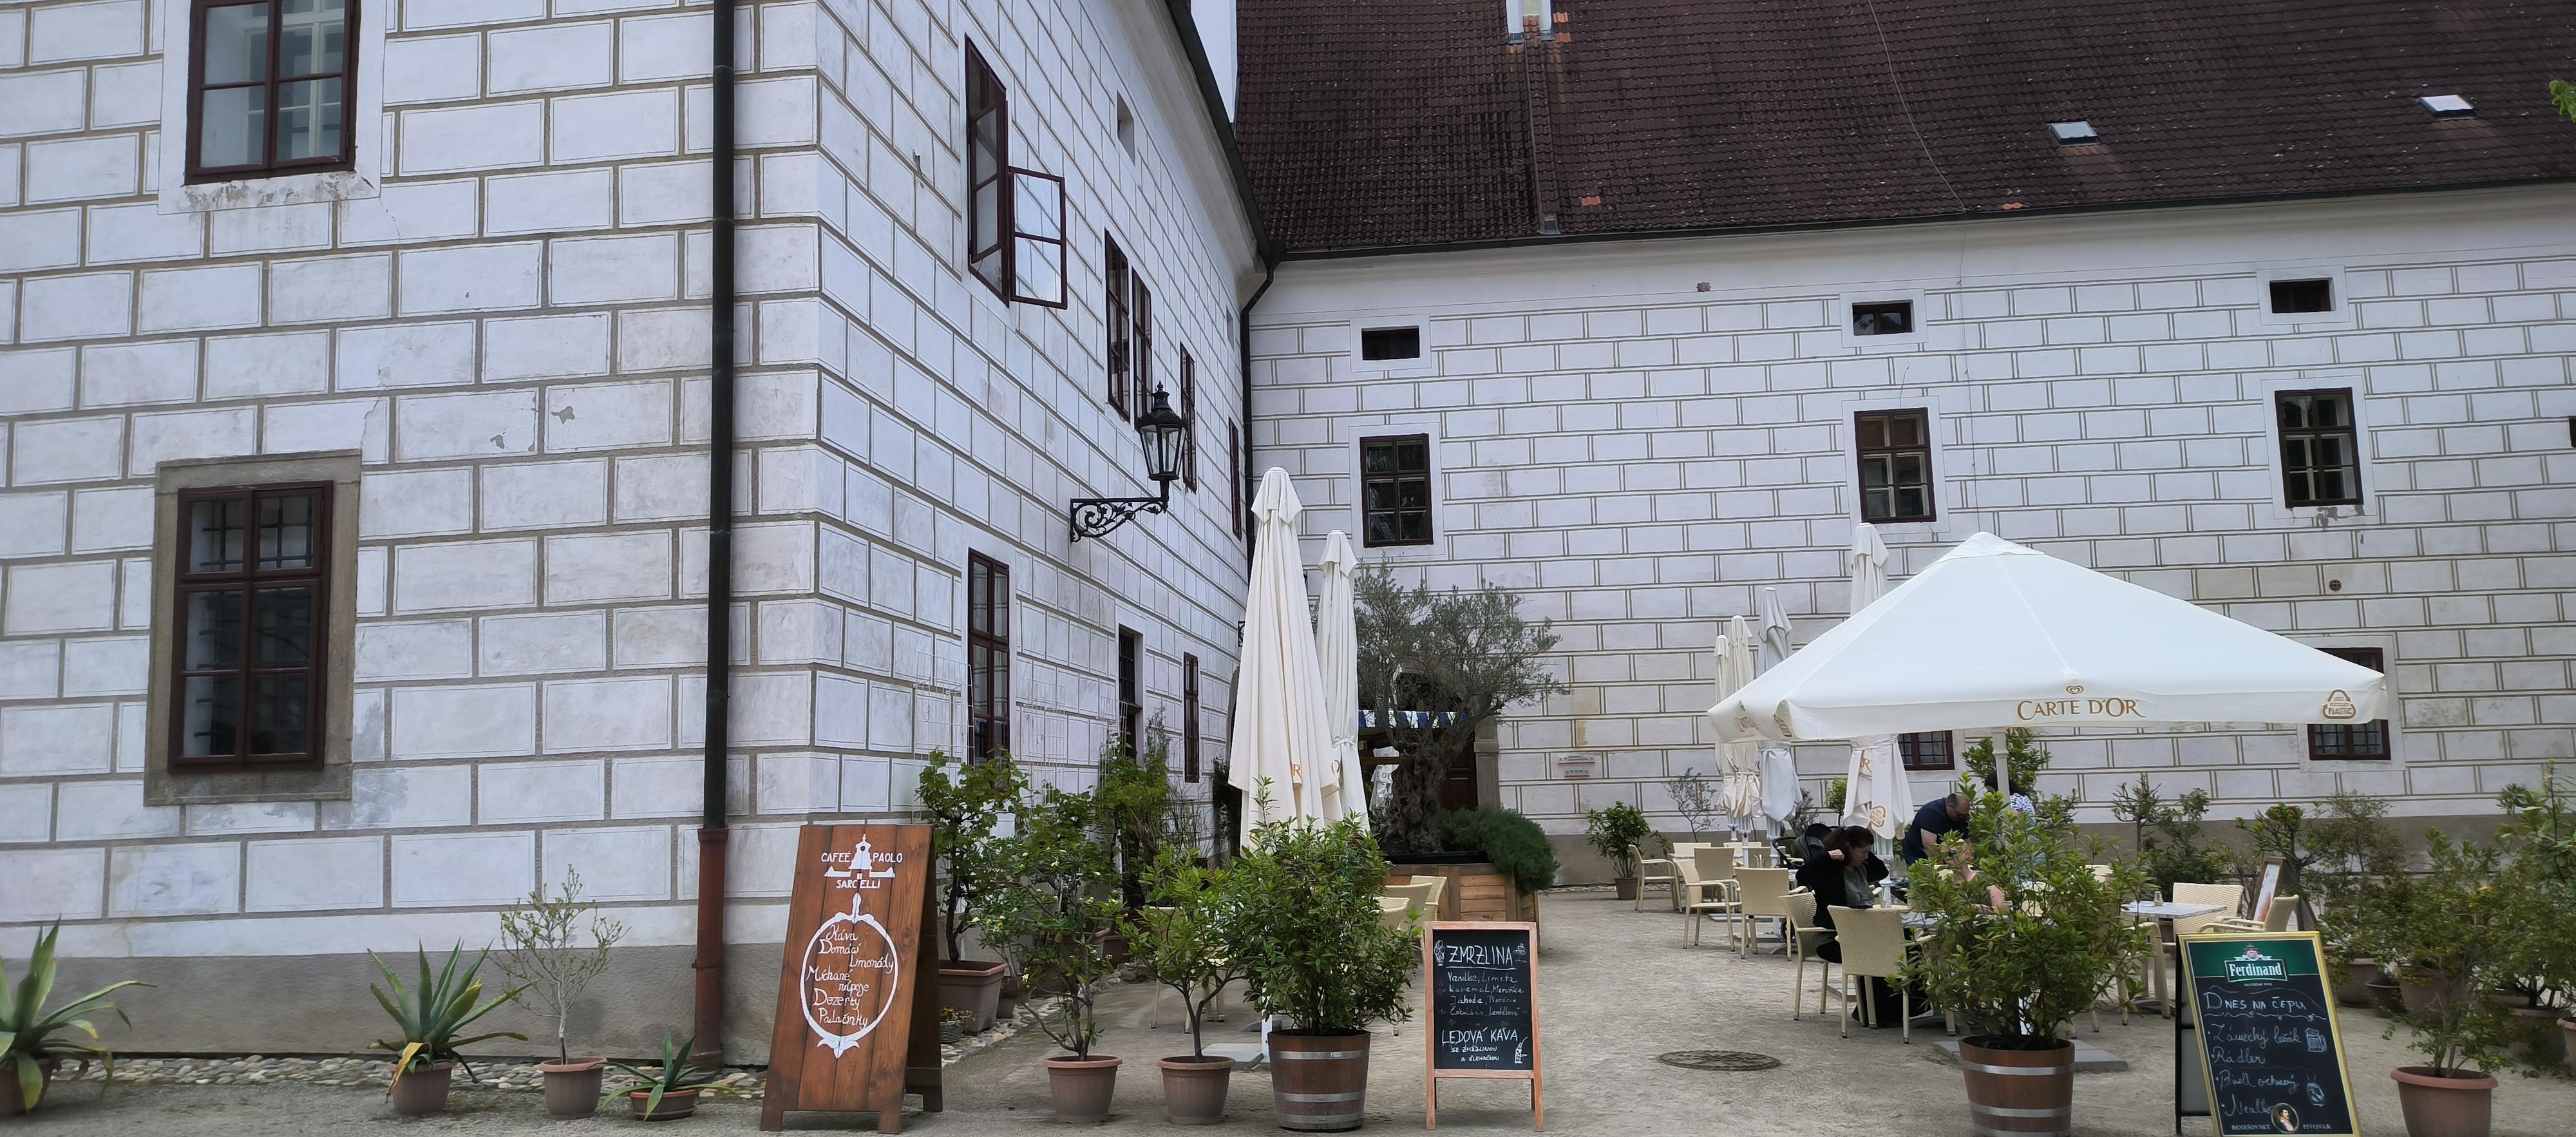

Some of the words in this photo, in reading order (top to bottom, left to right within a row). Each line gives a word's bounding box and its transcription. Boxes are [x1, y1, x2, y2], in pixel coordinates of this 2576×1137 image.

[2016, 700, 2081, 721] CARTE
[872, 852, 903, 863] PAOLO
[1446, 945, 1513, 966] ZMRZLINA
[2228, 962, 2282, 977] Ferdinand
[812, 988, 860, 1010] Dezerty
[2252, 1000, 2266, 1010] NA
[1490, 1027, 1518, 1043] KÁVA
[2273, 1026, 2302, 1044] ležák
